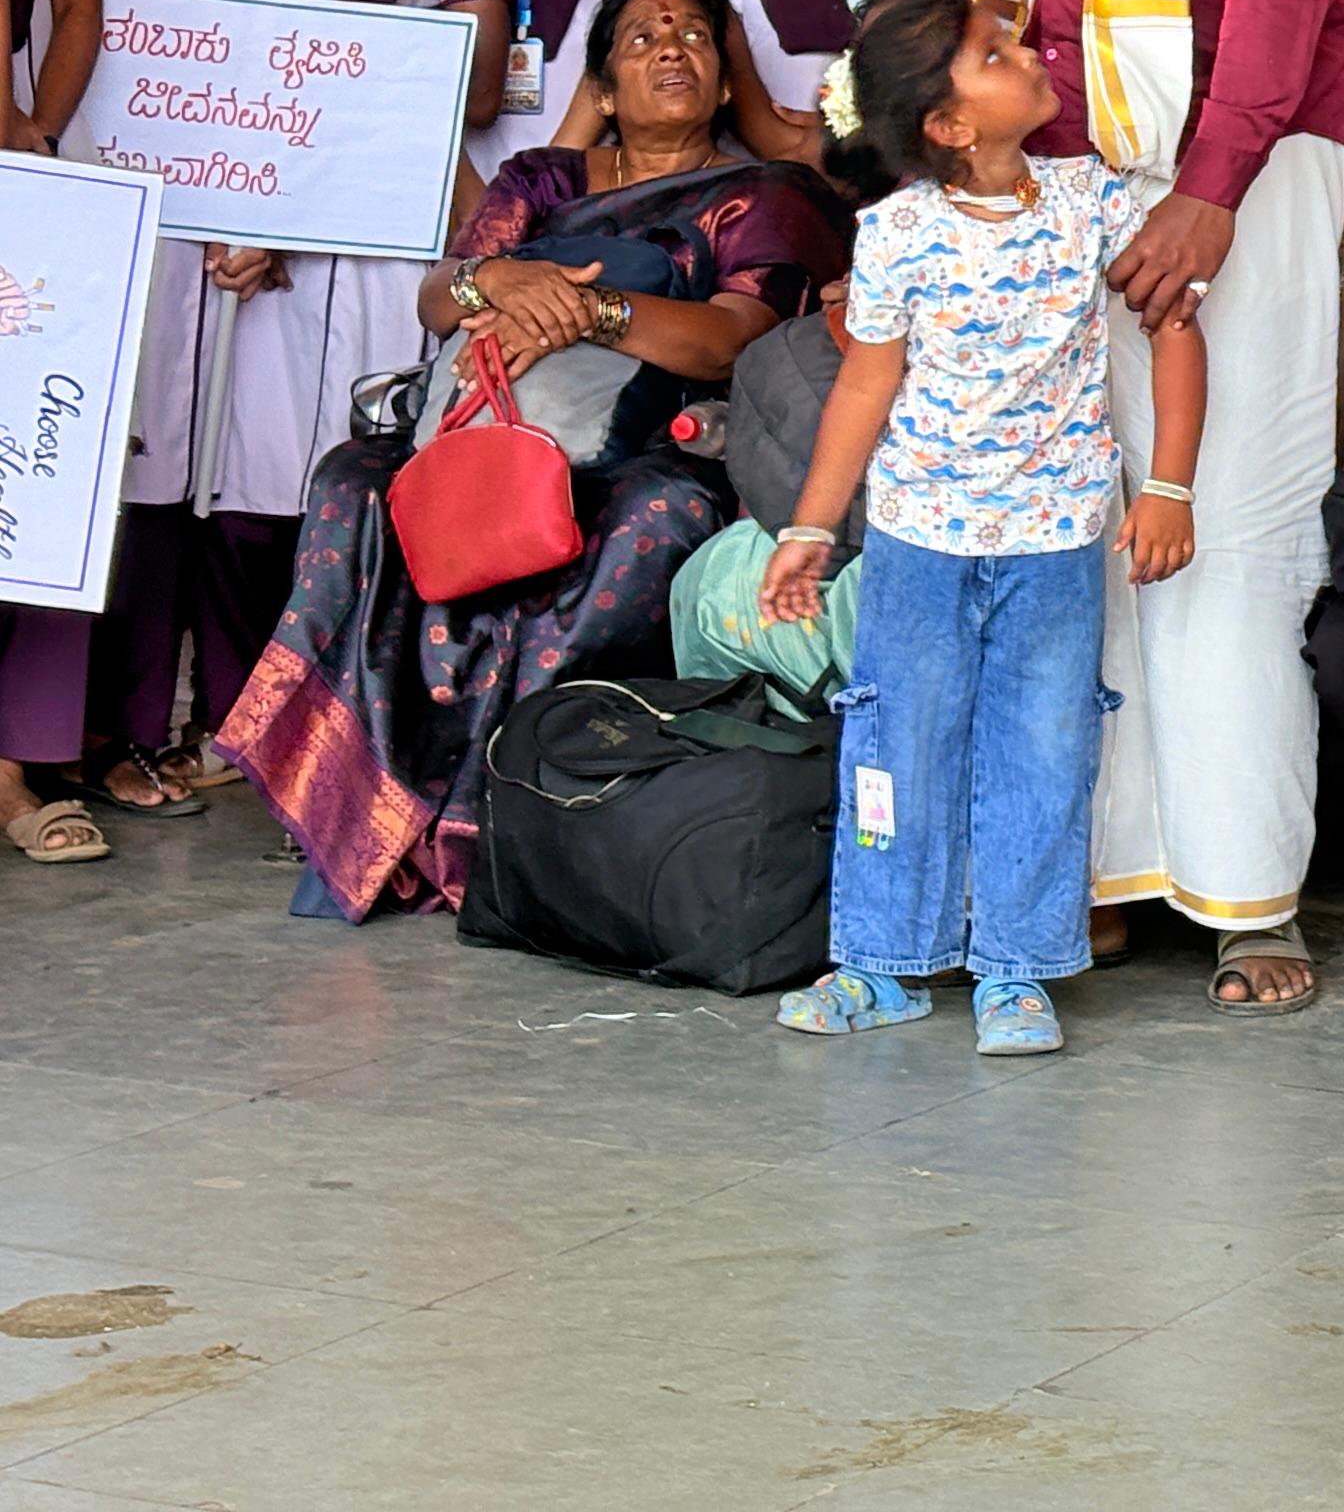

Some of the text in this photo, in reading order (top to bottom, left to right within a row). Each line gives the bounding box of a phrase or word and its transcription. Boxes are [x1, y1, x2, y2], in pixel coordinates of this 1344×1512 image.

[101, 9, 232, 65] ತಂಬಾಕು
[128, 78, 323, 148] ಜೀವನವನ್ನು
[32, 373, 85, 478] Choose
